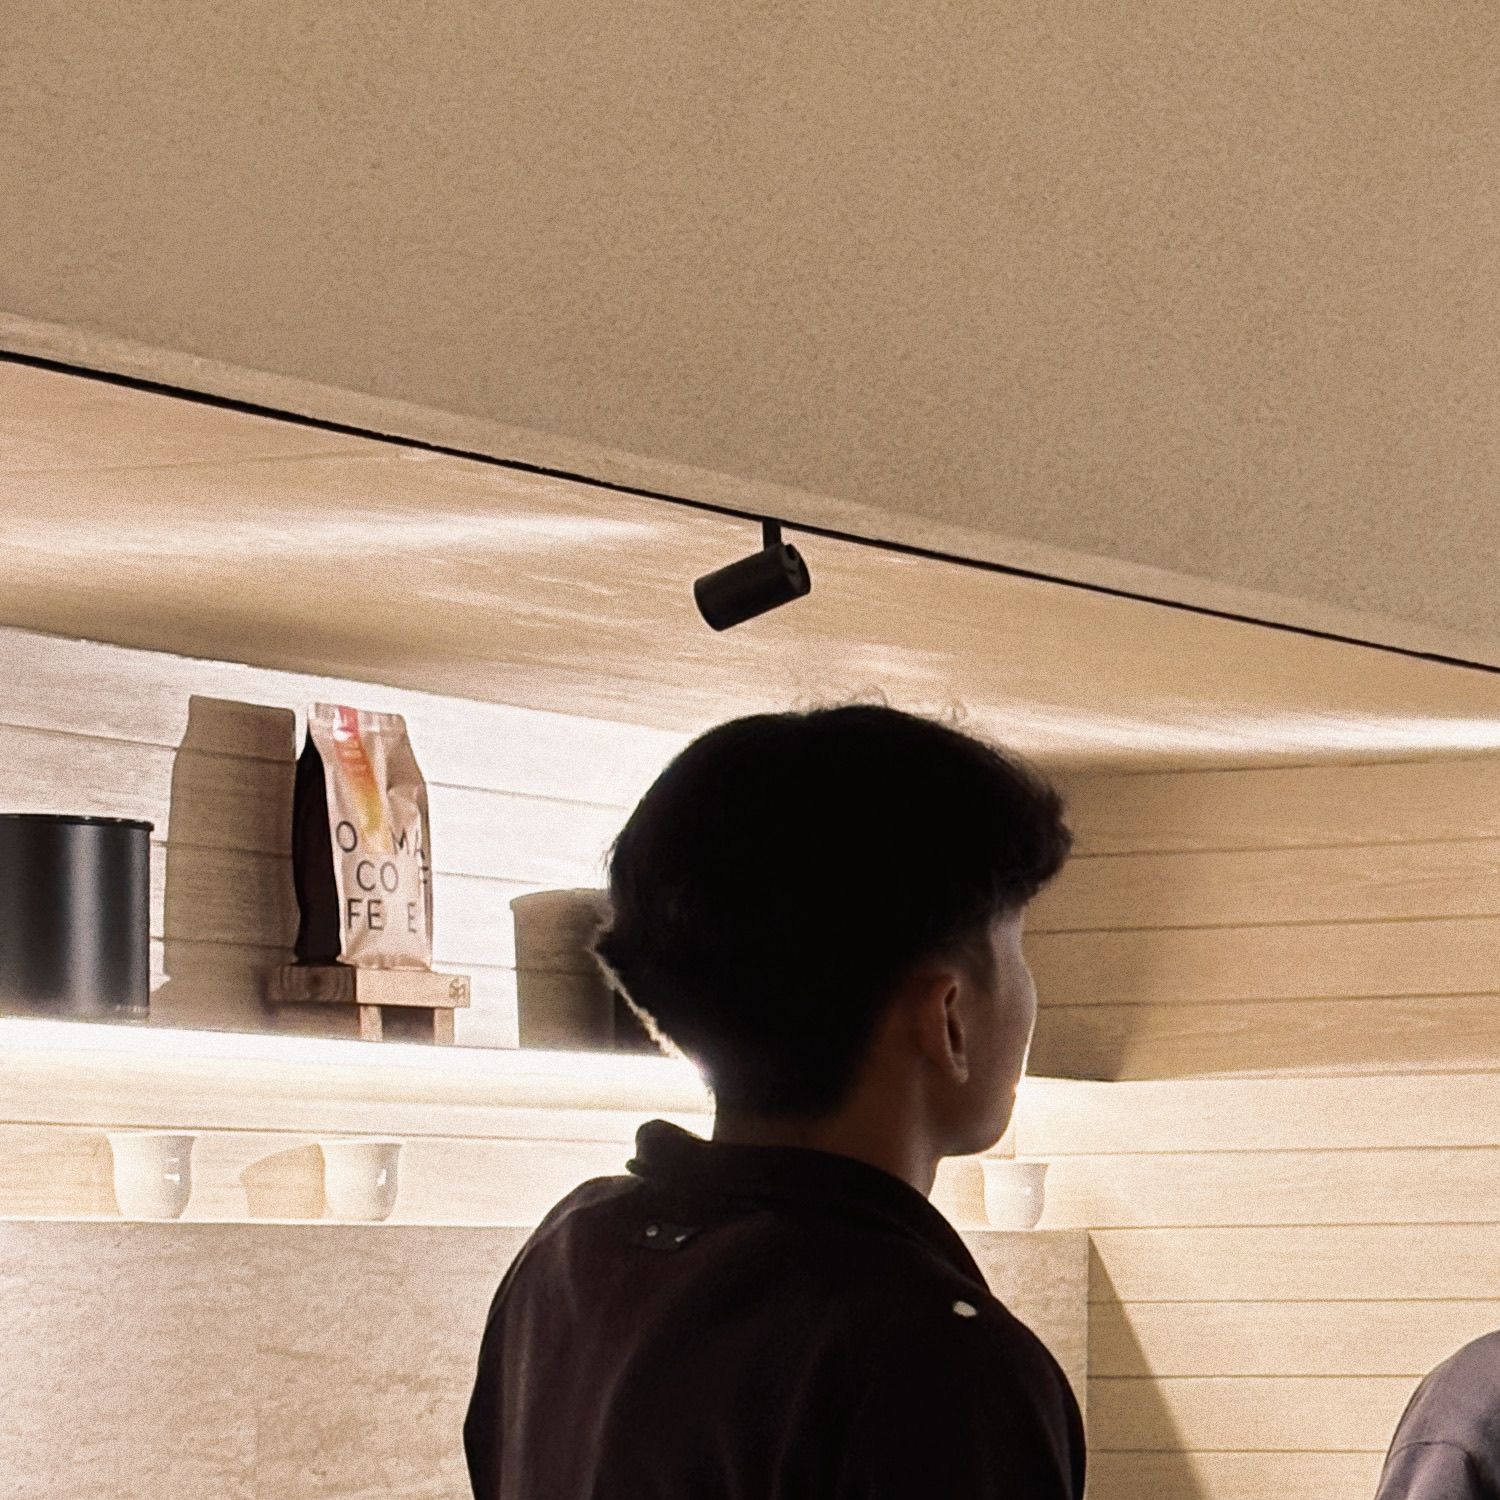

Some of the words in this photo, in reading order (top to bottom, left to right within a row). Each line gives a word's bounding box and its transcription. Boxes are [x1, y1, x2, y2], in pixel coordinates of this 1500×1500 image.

[336, 820, 358, 853] O
[356, 860, 399, 893] CO
[347, 898, 385, 931] FE
[407, 902, 418, 933] E
